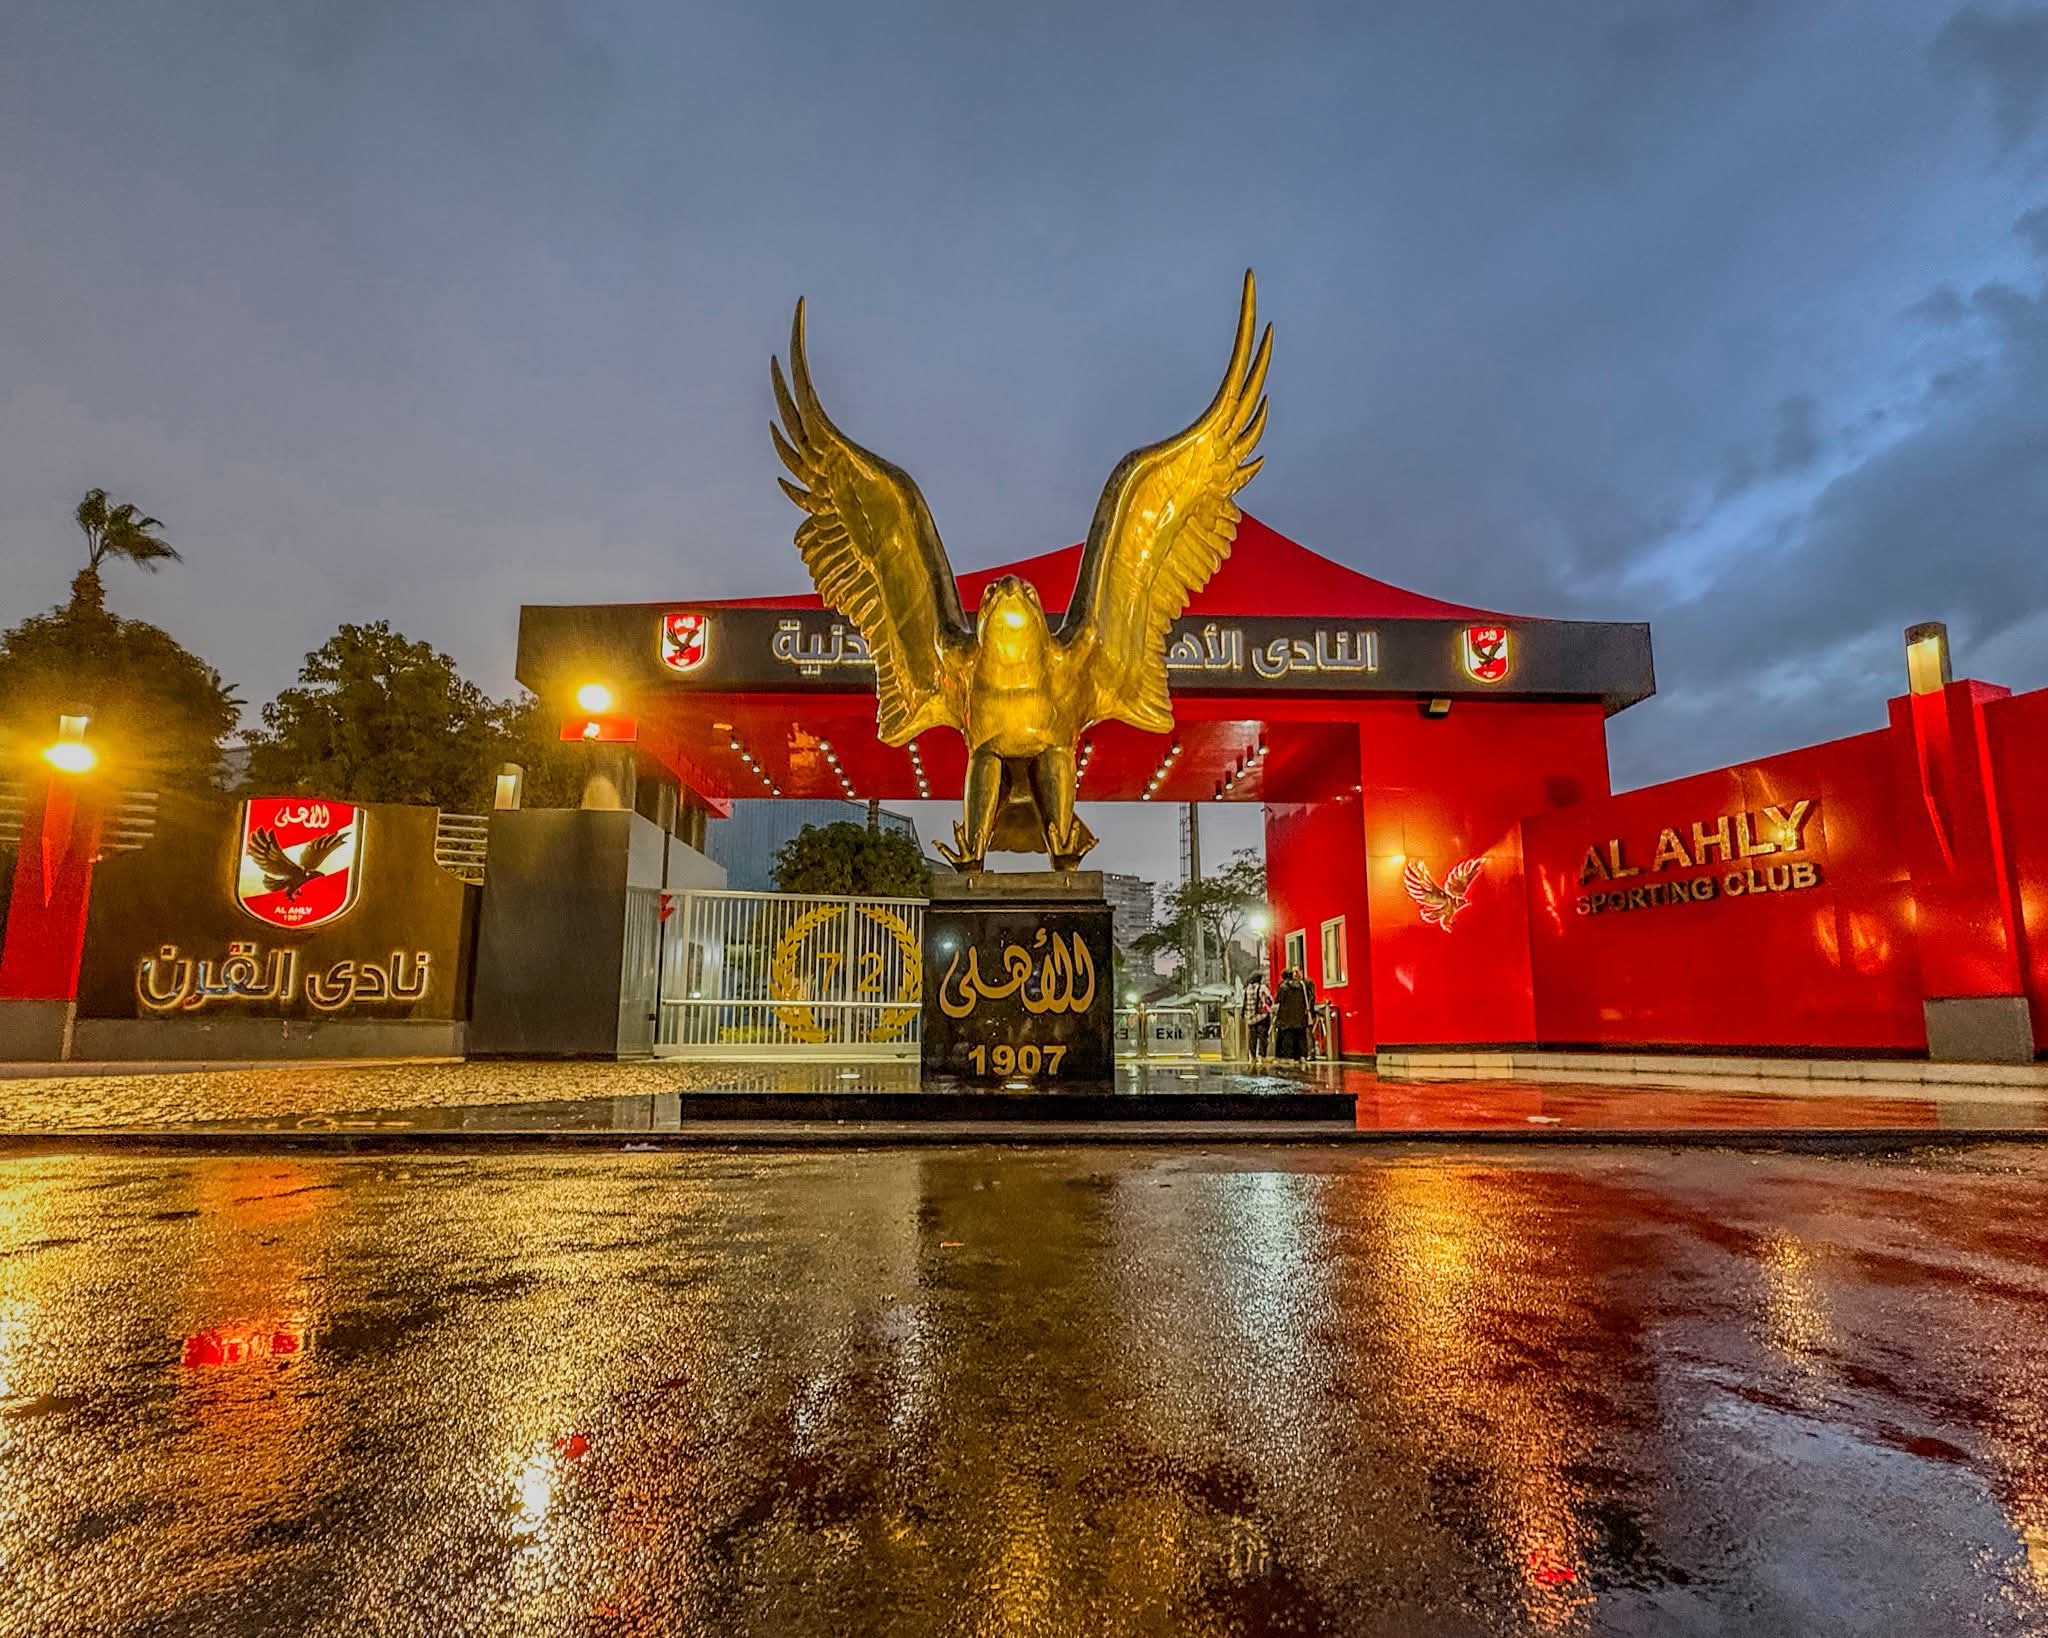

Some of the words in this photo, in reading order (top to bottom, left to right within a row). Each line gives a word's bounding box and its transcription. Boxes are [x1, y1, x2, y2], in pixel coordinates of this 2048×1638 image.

[772, 619, 876, 675] دنية
[1165, 624, 1243, 669] الأه
[1252, 630, 1377, 679] النادى
[1579, 839, 1640, 884] AL
[1653, 800, 1810, 872] AHLY
[1576, 877, 1714, 916] SPORTING
[1724, 862, 1818, 897] CLUB
[137, 943, 296, 1010] القرن
[305, 951, 429, 1011] نادى
[968, 1045, 1067, 1076] 1907
[1156, 1028, 1184, 1040] Exit
